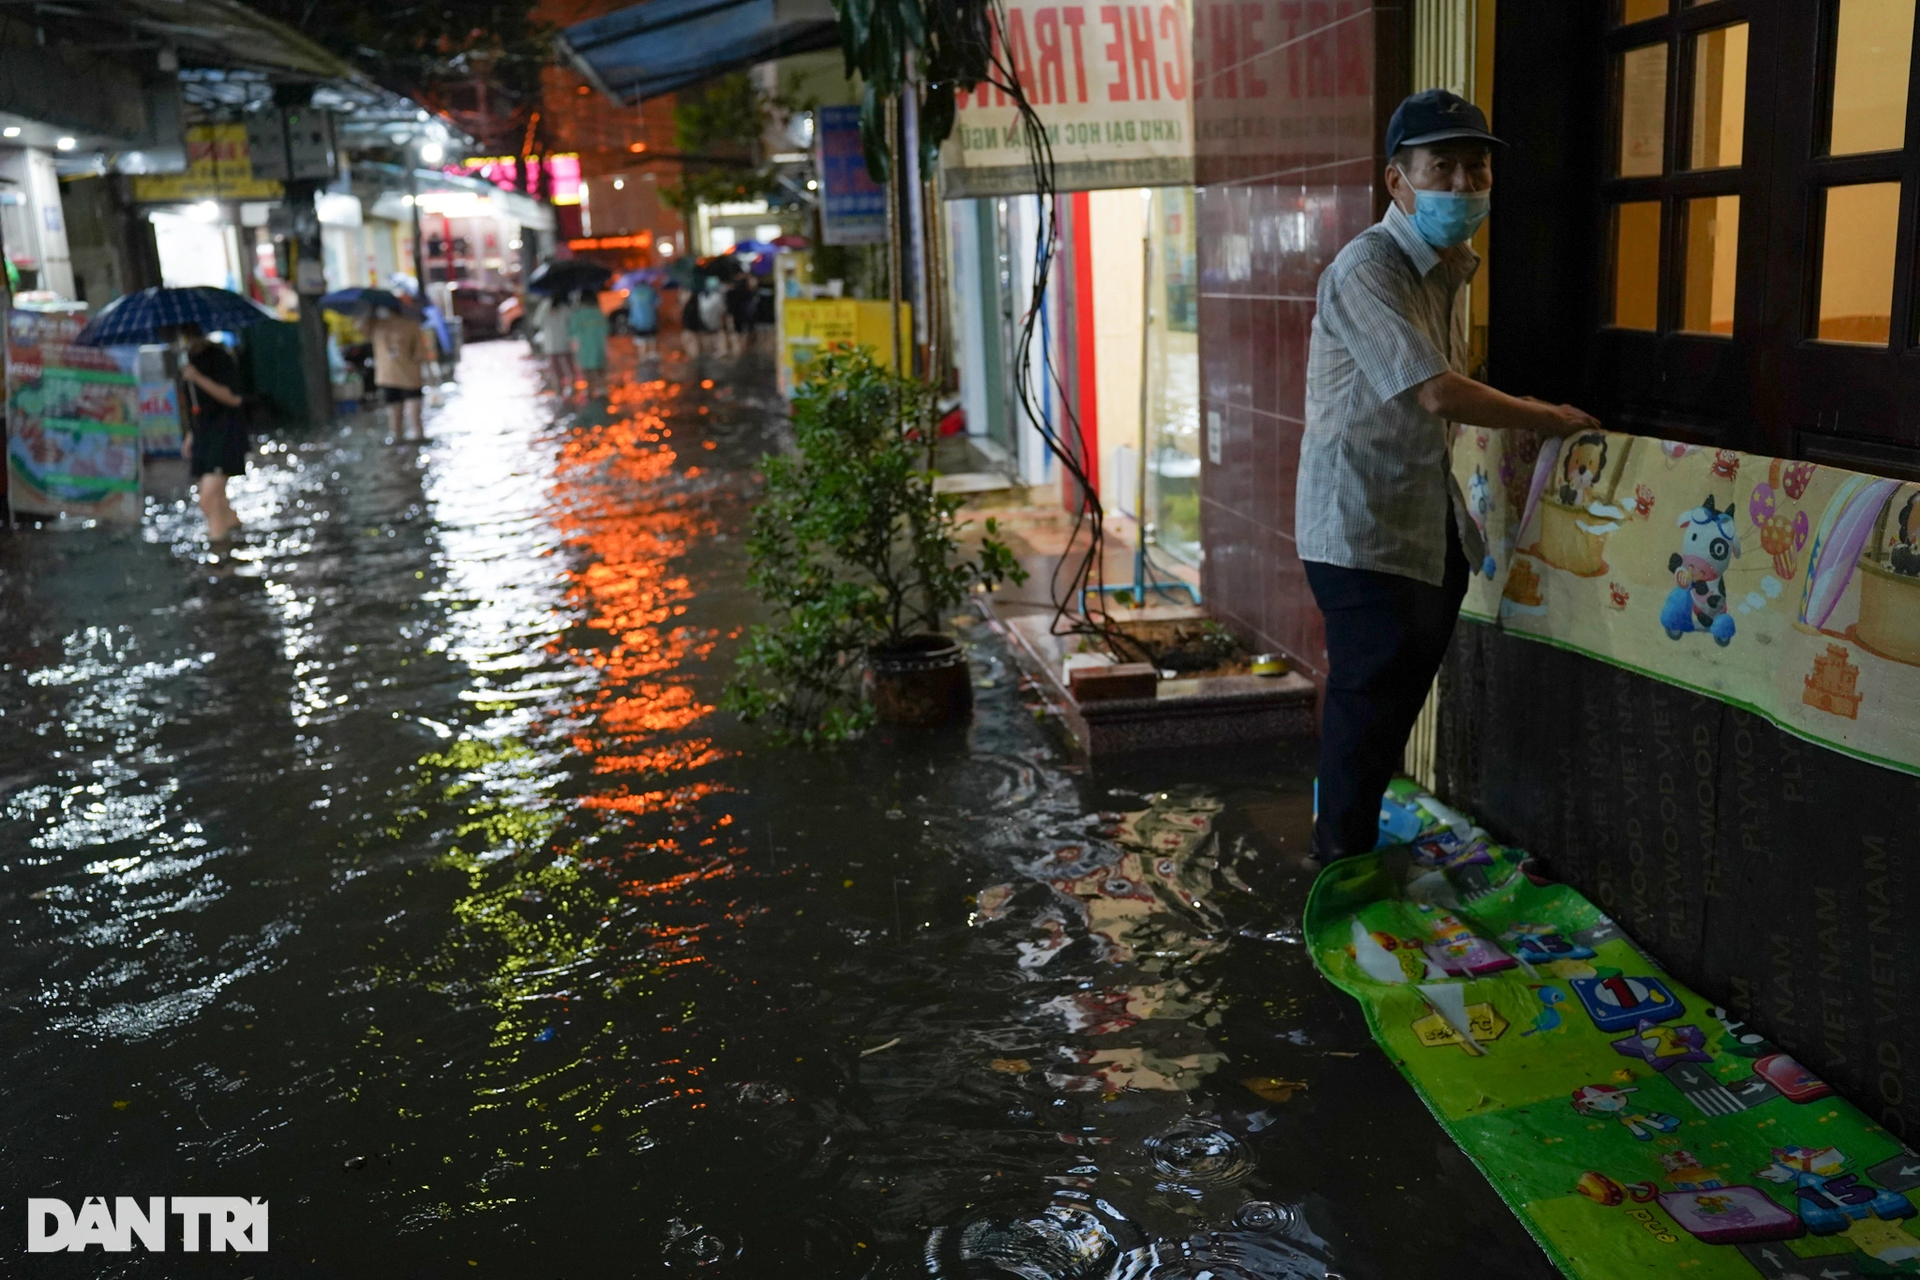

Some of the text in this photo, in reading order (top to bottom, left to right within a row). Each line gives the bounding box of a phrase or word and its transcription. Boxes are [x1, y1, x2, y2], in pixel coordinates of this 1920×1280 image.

[1693, 723, 1721, 898] PLYWOOD
[1659, 772, 1686, 940] PLYWOOD
[1862, 834, 1892, 935] NAM
[1602, 977, 1640, 1009] 1
[1814, 886, 1847, 1068] VIET NAM
[1870, 943, 1897, 1025] VIET
[1642, 1025, 1690, 1058] 2
[1625, 1208, 1679, 1244] end
[1793, 1173, 1878, 1209] 15
